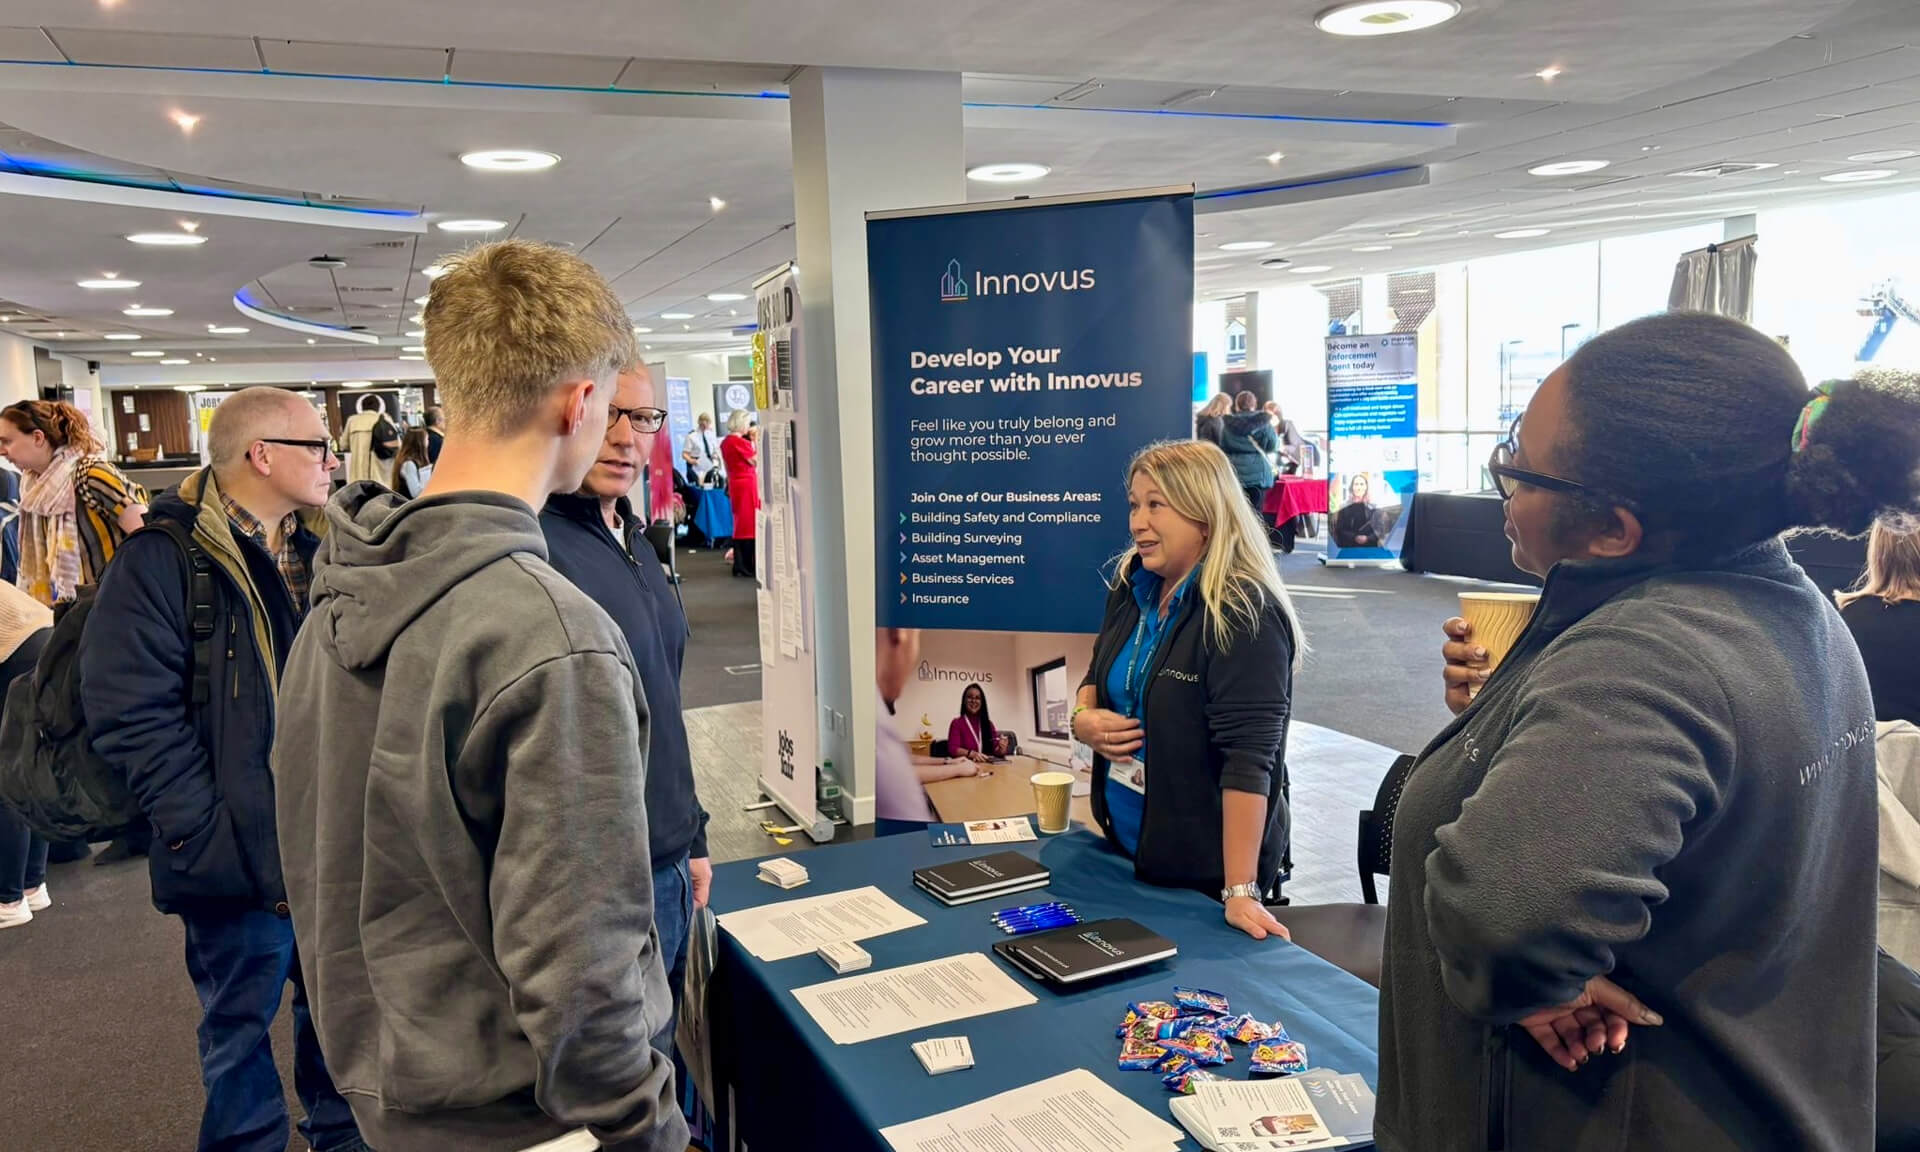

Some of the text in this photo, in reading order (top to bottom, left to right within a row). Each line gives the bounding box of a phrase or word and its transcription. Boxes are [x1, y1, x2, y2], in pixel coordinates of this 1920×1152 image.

[976, 269, 1095, 295] Innovus
[1327, 343, 1358, 351] Become
[911, 347, 1061, 370] Develop Your
[1327, 352, 1377, 361] Enforcement
[1327, 361, 1375, 372] Agent today
[911, 372, 1142, 395] Career with Innovus
[911, 414, 1116, 433] Feel like you truly belong and
[911, 433, 1085, 452] grow more than you ever
[911, 448, 1030, 464] thought possible.
[911, 491, 1101, 502] Join One of Our Business Areas:
[912, 512, 1101, 525] Building Safety and Compliance
[912, 532, 1021, 545] Building Surveying
[912, 553, 1025, 565] Asset Management
[913, 573, 1014, 584] Business Services
[913, 593, 969, 604] Insurance
[934, 667, 993, 682] Innovus
